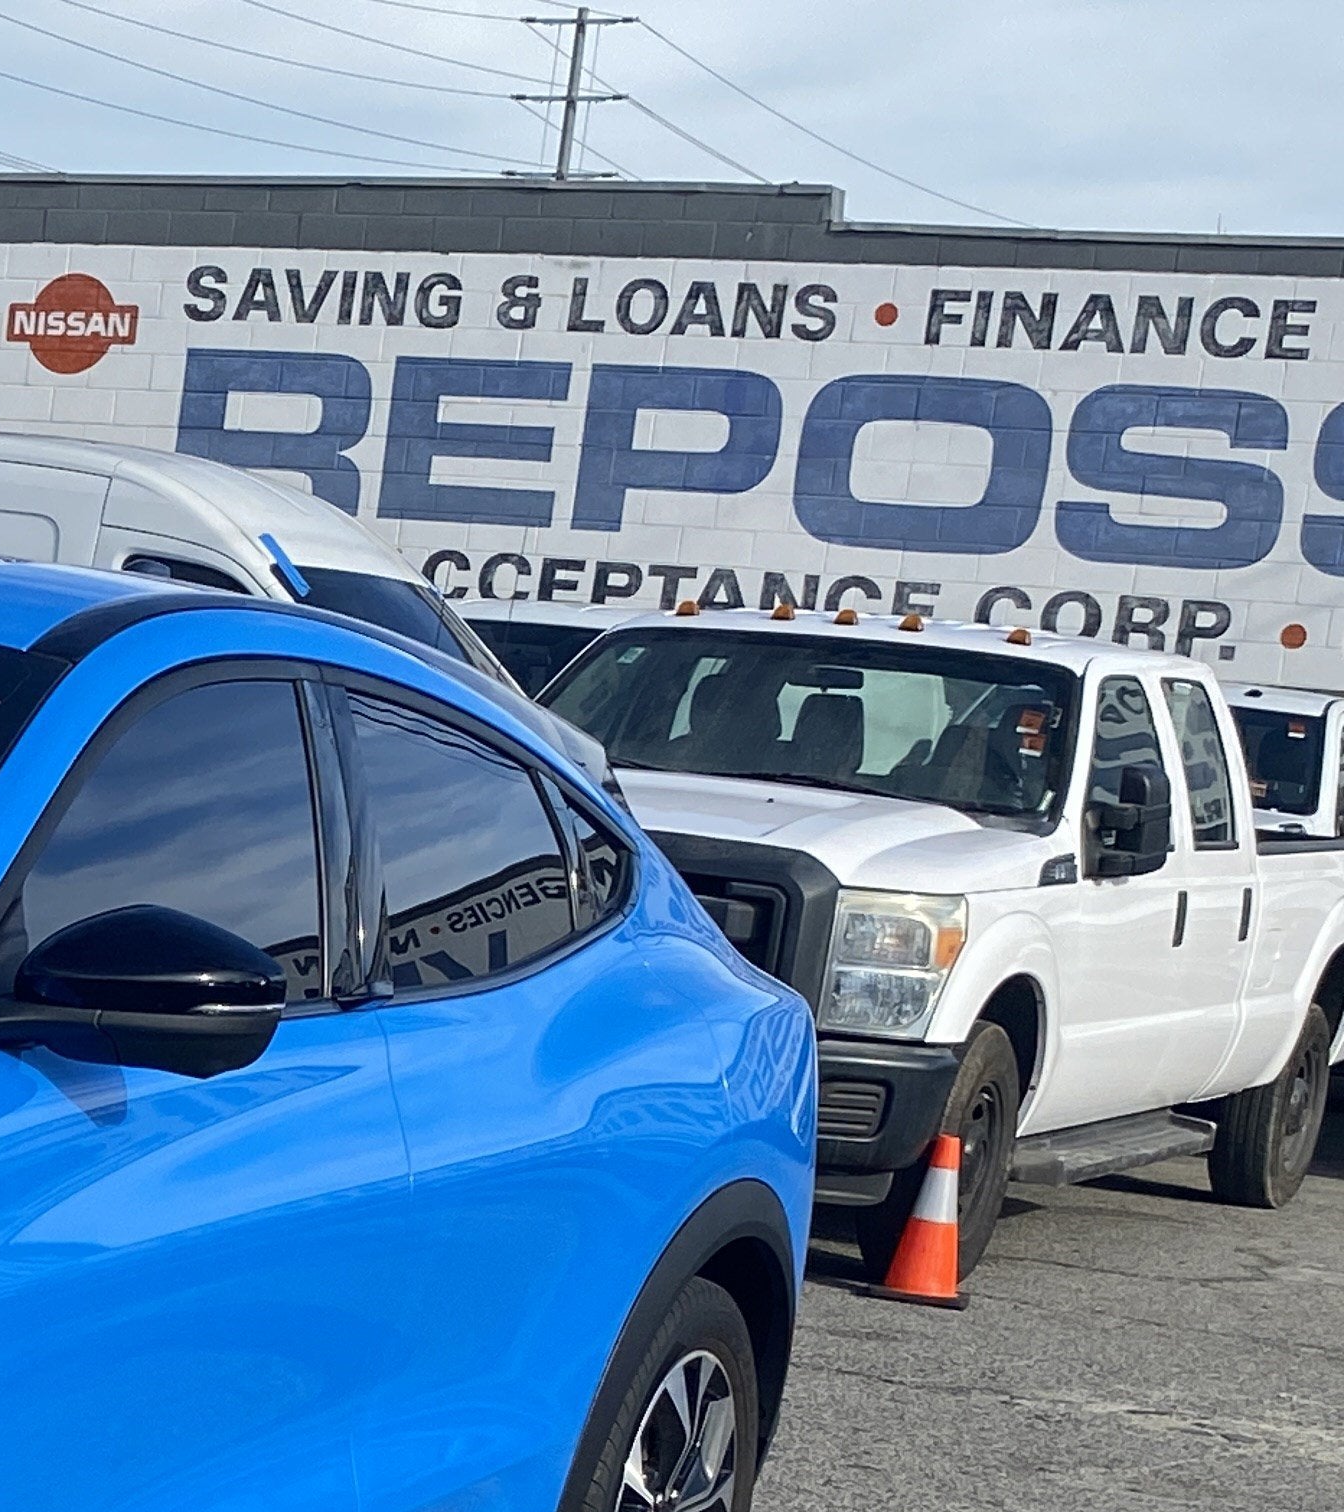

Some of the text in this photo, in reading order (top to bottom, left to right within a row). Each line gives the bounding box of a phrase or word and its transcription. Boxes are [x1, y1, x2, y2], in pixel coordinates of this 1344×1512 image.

[13, 310, 132, 338] NISSAN
[183, 265, 1317, 360] SAVING & LOANS FINANCE
[175, 347, 1344, 577] REPOS
[421, 549, 1235, 660] CCEPTANCE CORP.
